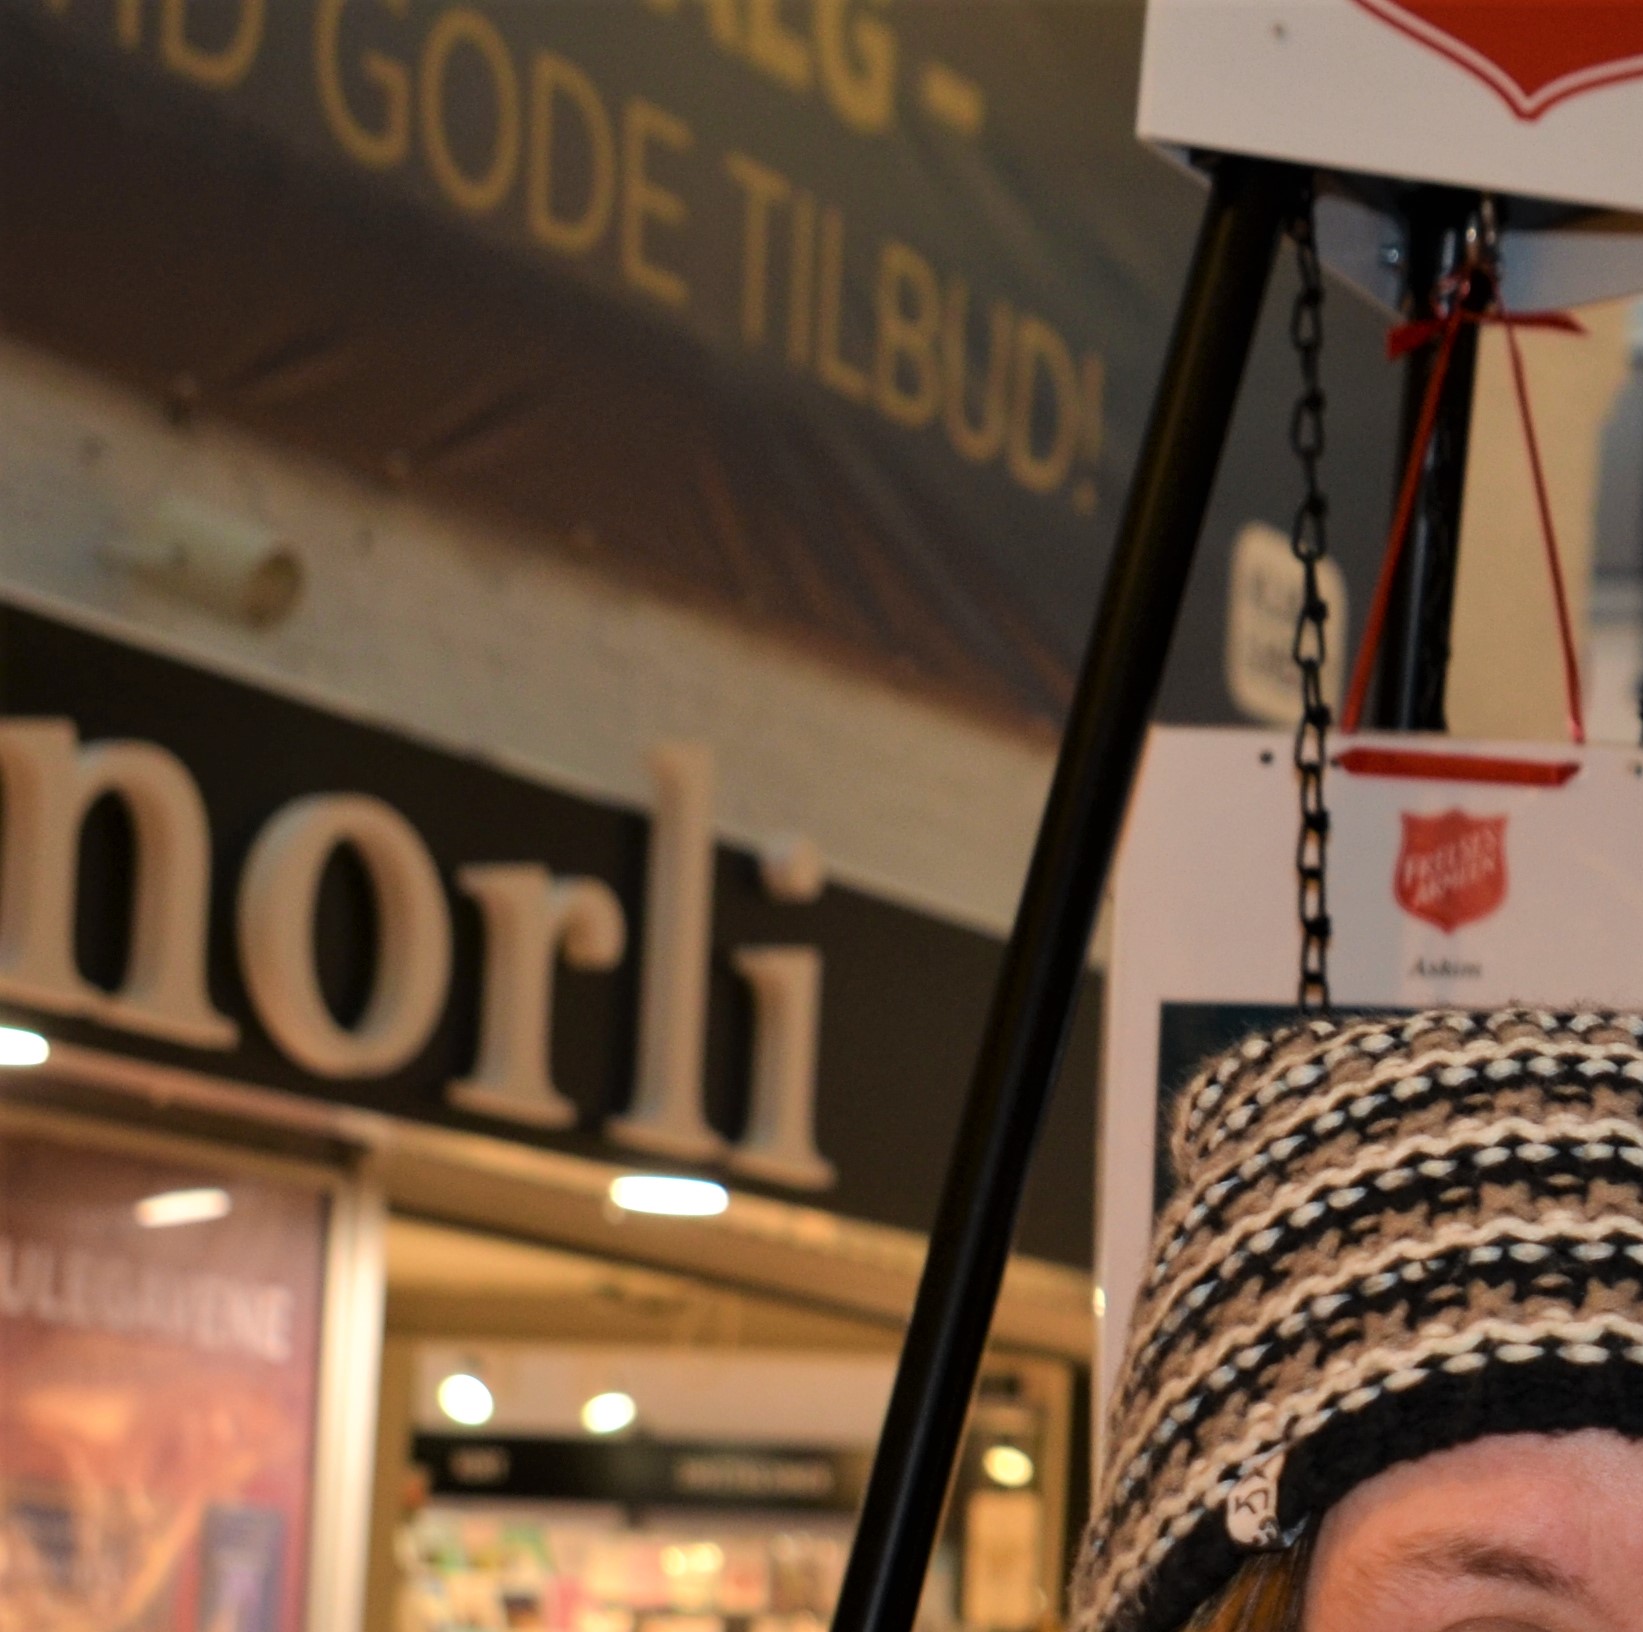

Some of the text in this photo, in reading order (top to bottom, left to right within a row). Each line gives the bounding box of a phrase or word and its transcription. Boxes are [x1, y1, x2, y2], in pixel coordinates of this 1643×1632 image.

[313, 0, 695, 304] GODE
[724, 150, 1105, 516] TILBUD!
[0, 714, 838, 1190] norli
